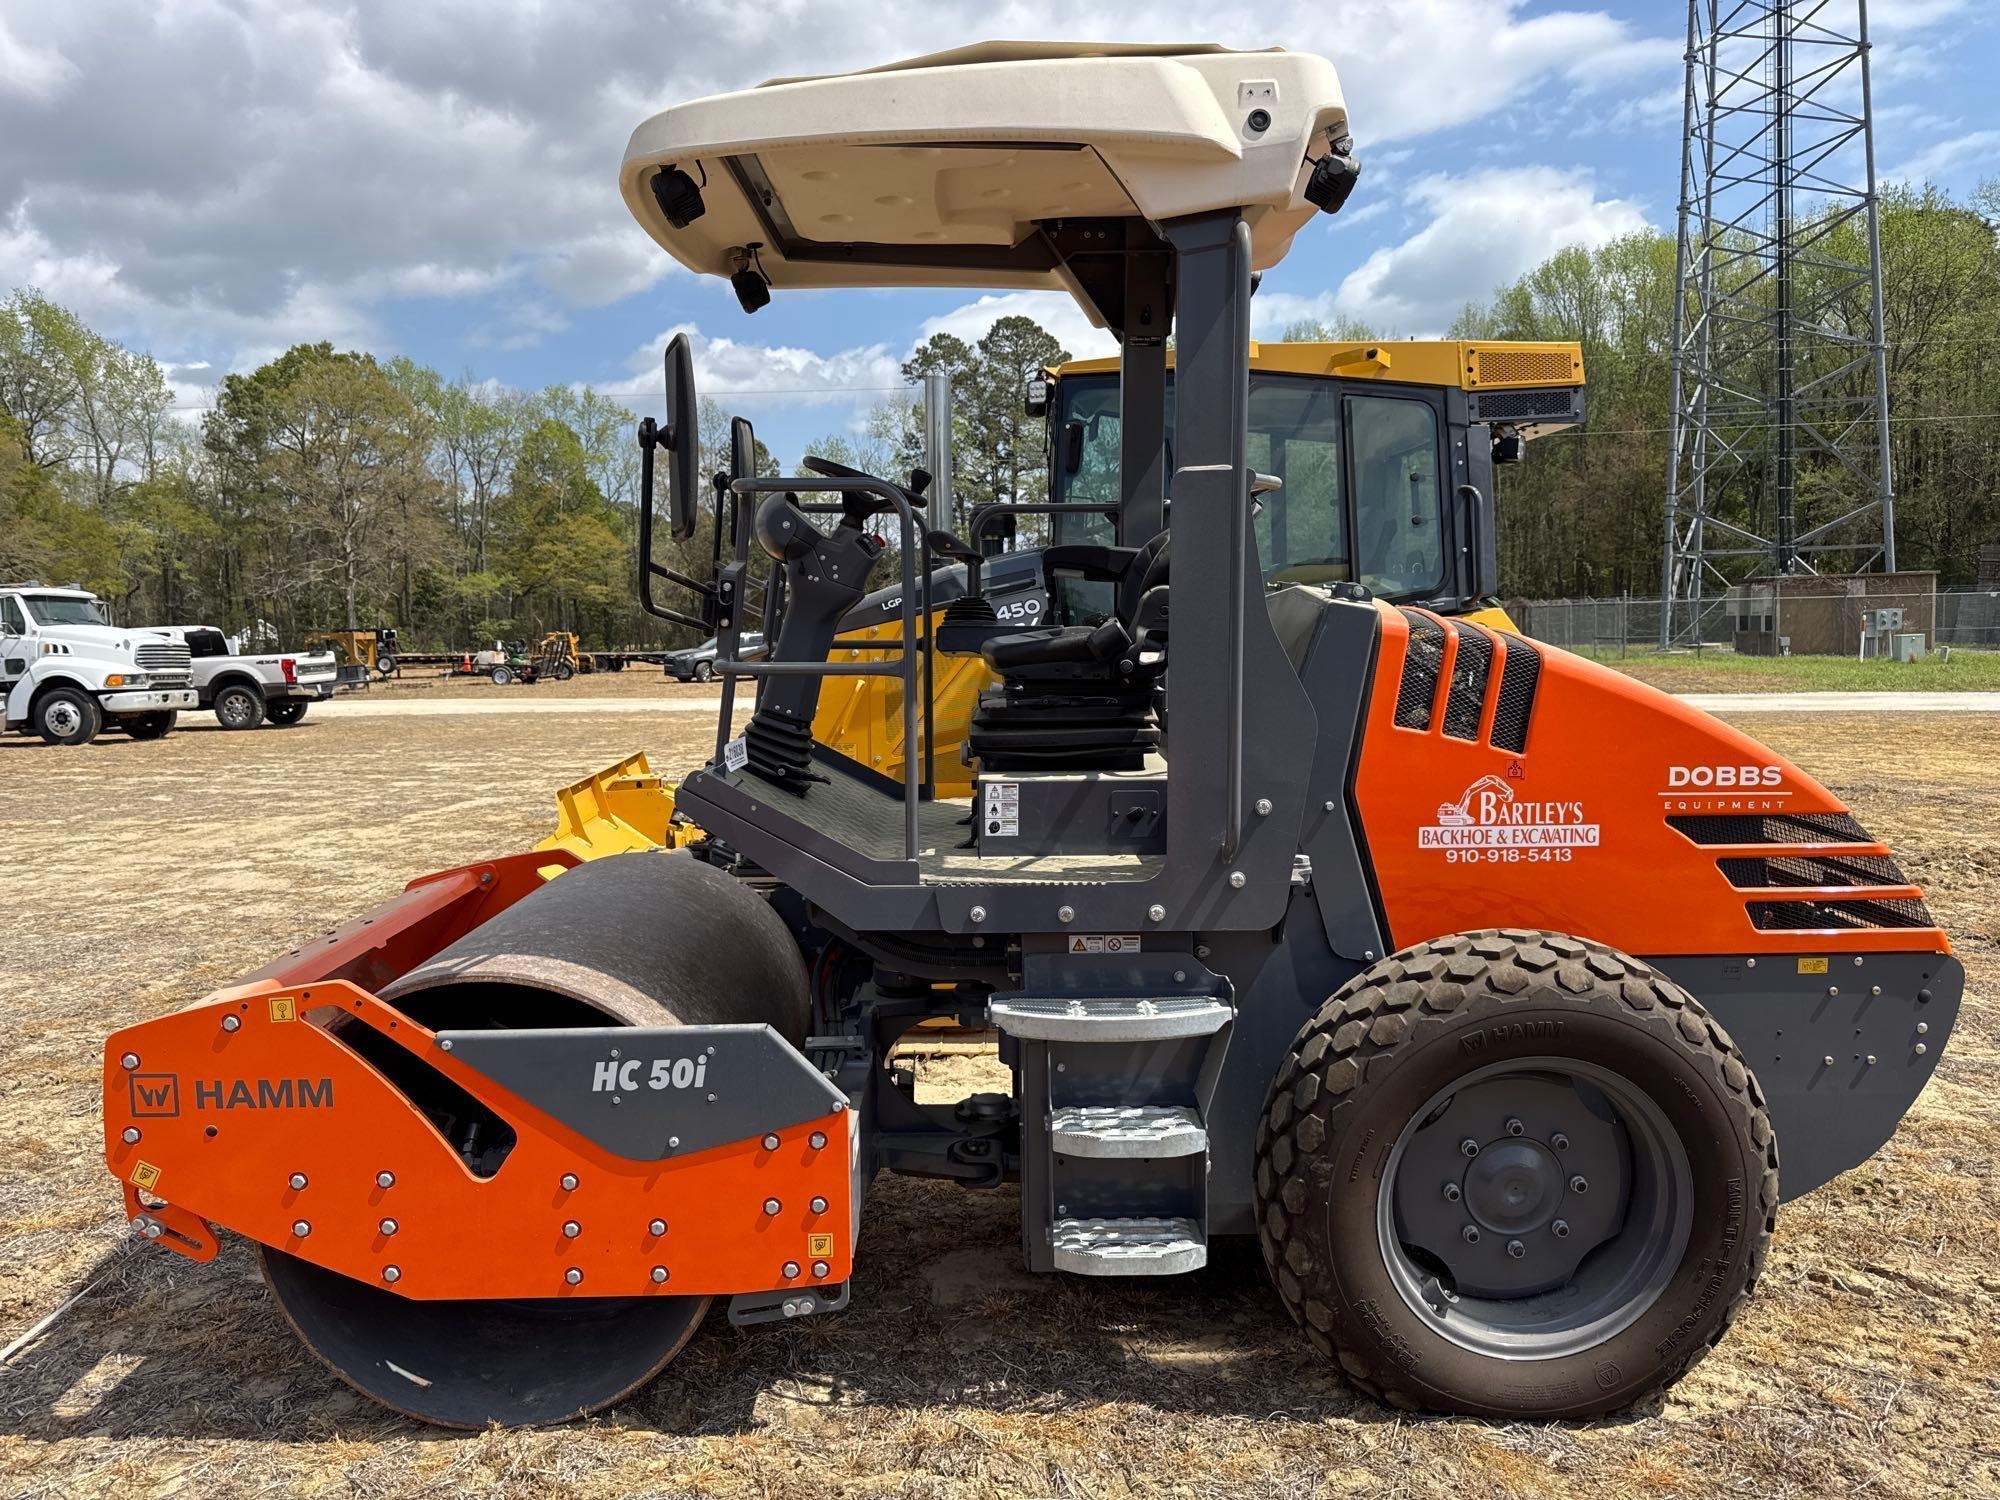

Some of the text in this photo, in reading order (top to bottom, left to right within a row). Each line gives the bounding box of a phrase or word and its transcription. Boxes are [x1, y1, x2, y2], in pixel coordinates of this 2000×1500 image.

[881, 597, 902, 611] LGP
[997, 599, 1041, 620] 450
[1668, 766, 1782, 786] DOBBS
[1664, 801, 1785, 810] EQUIPMENT
[1421, 827, 1597, 846] BACKHOE & EXCAVATING
[1446, 848, 1573, 863] 910-918-5413
[1492, 1021, 1565, 1041] HAMM
[592, 1054, 707, 1091] HC 50i
[195, 1078, 334, 1109] HAMM
